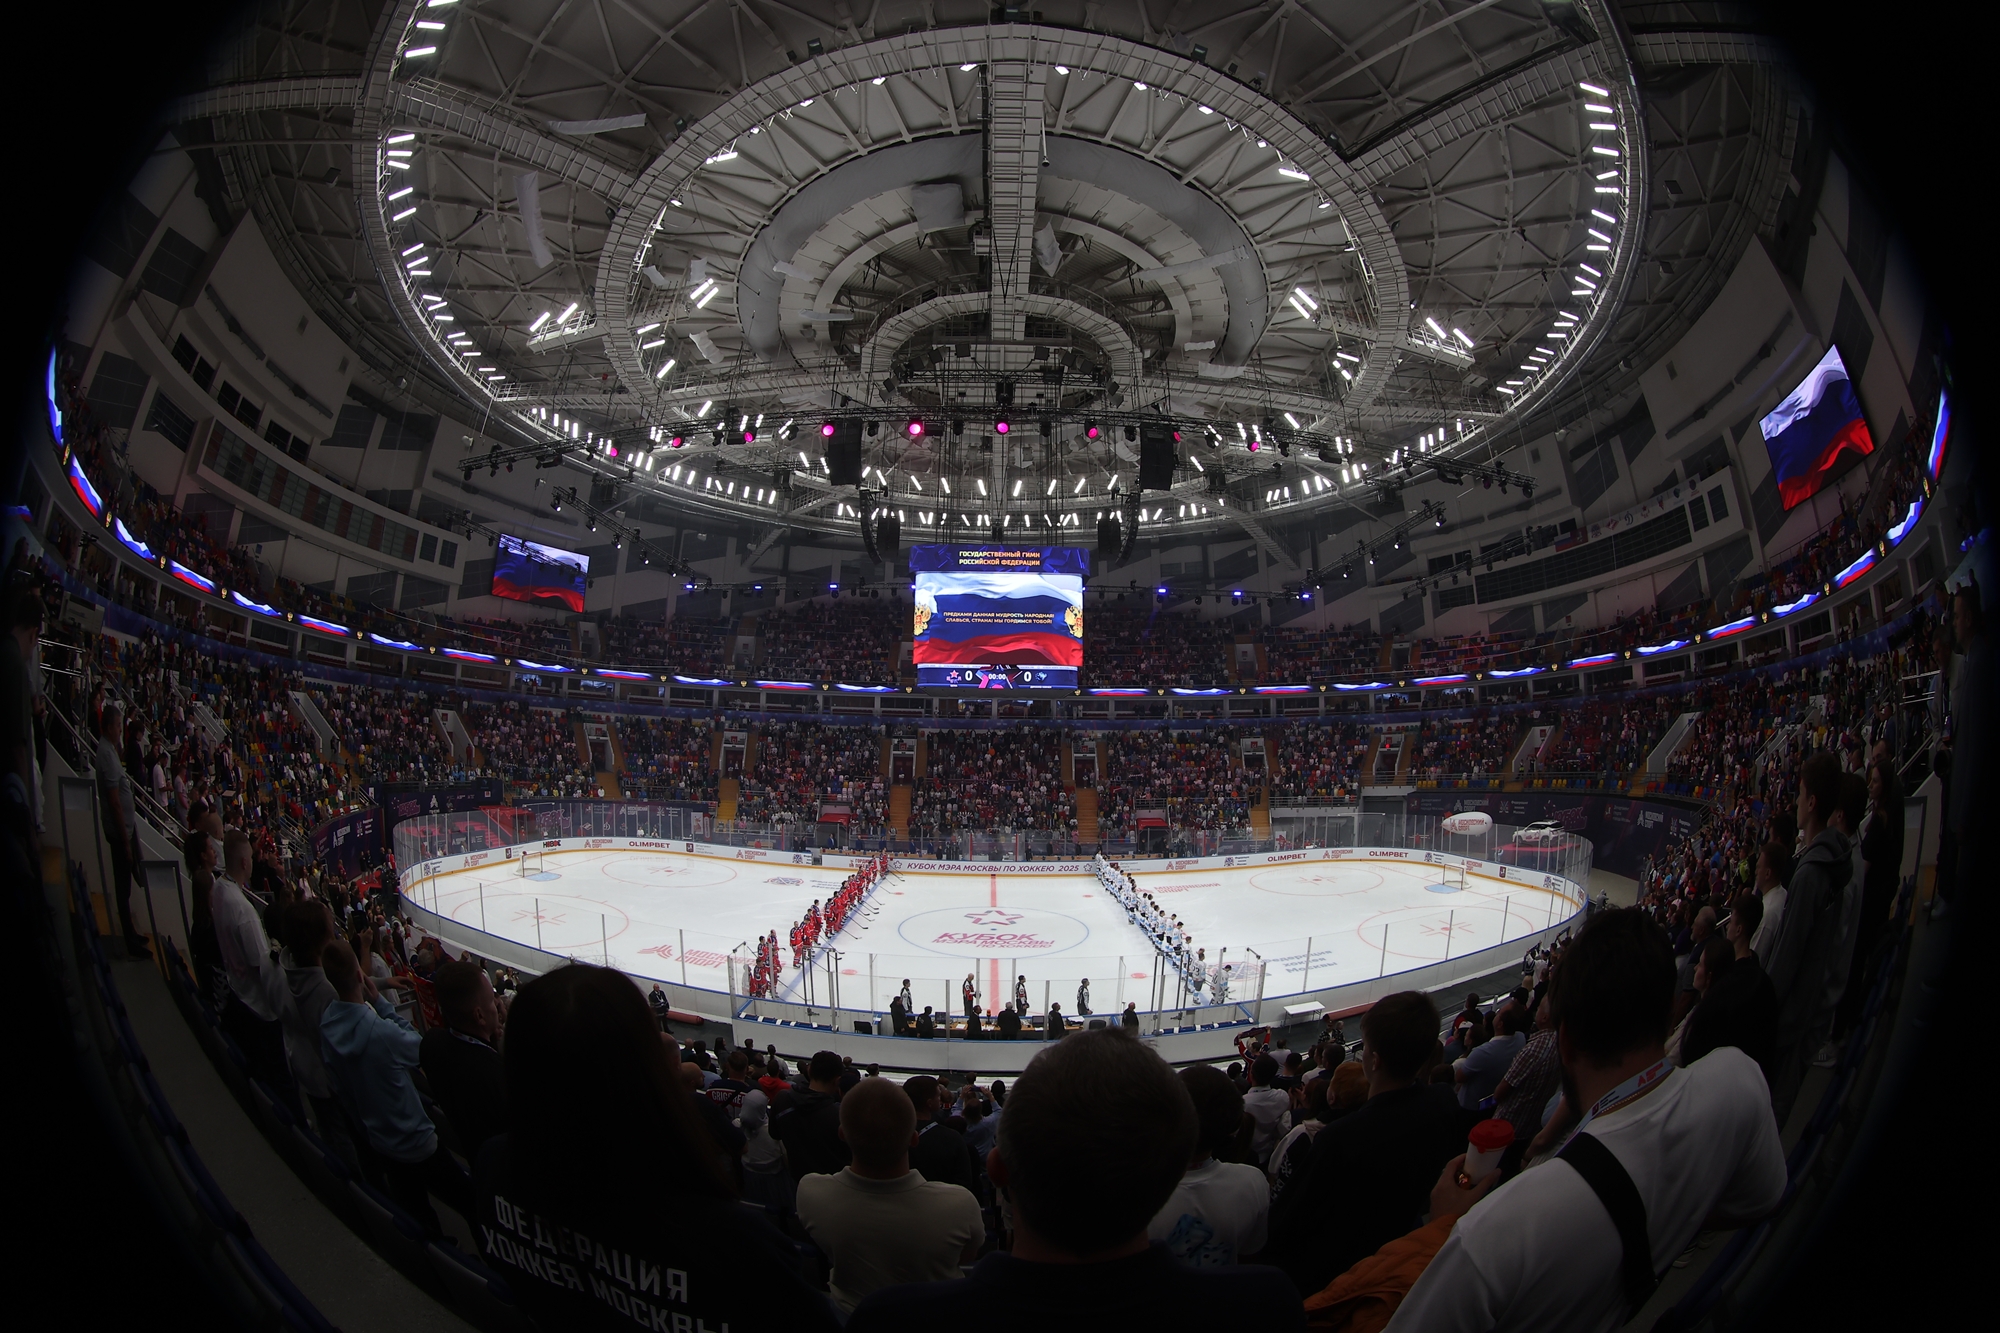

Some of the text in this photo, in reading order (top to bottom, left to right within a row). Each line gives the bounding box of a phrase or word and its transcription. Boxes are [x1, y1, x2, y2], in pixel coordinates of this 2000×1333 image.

[959, 550, 1021, 558] ГОСУДАРСТВЕННЫЙ
[965, 670, 973, 681] 0
[1024, 671, 1032, 682] 0
[629, 841, 671, 849] OLIMPBET
[1267, 853, 1307, 862] OLIMPBET
[907, 862, 937, 870] КУБОК
[1017, 864, 1055, 872] ХОККЕЮ
[1058, 864, 1079, 872] 2025
[938, 933, 1038, 941] КУБОК
[1282, 957, 1327, 967] хокея
[494, 1194, 689, 1304] ФЕДЕРАЦИЯ
[481, 1224, 585, 1292] ХОККЕЯ
